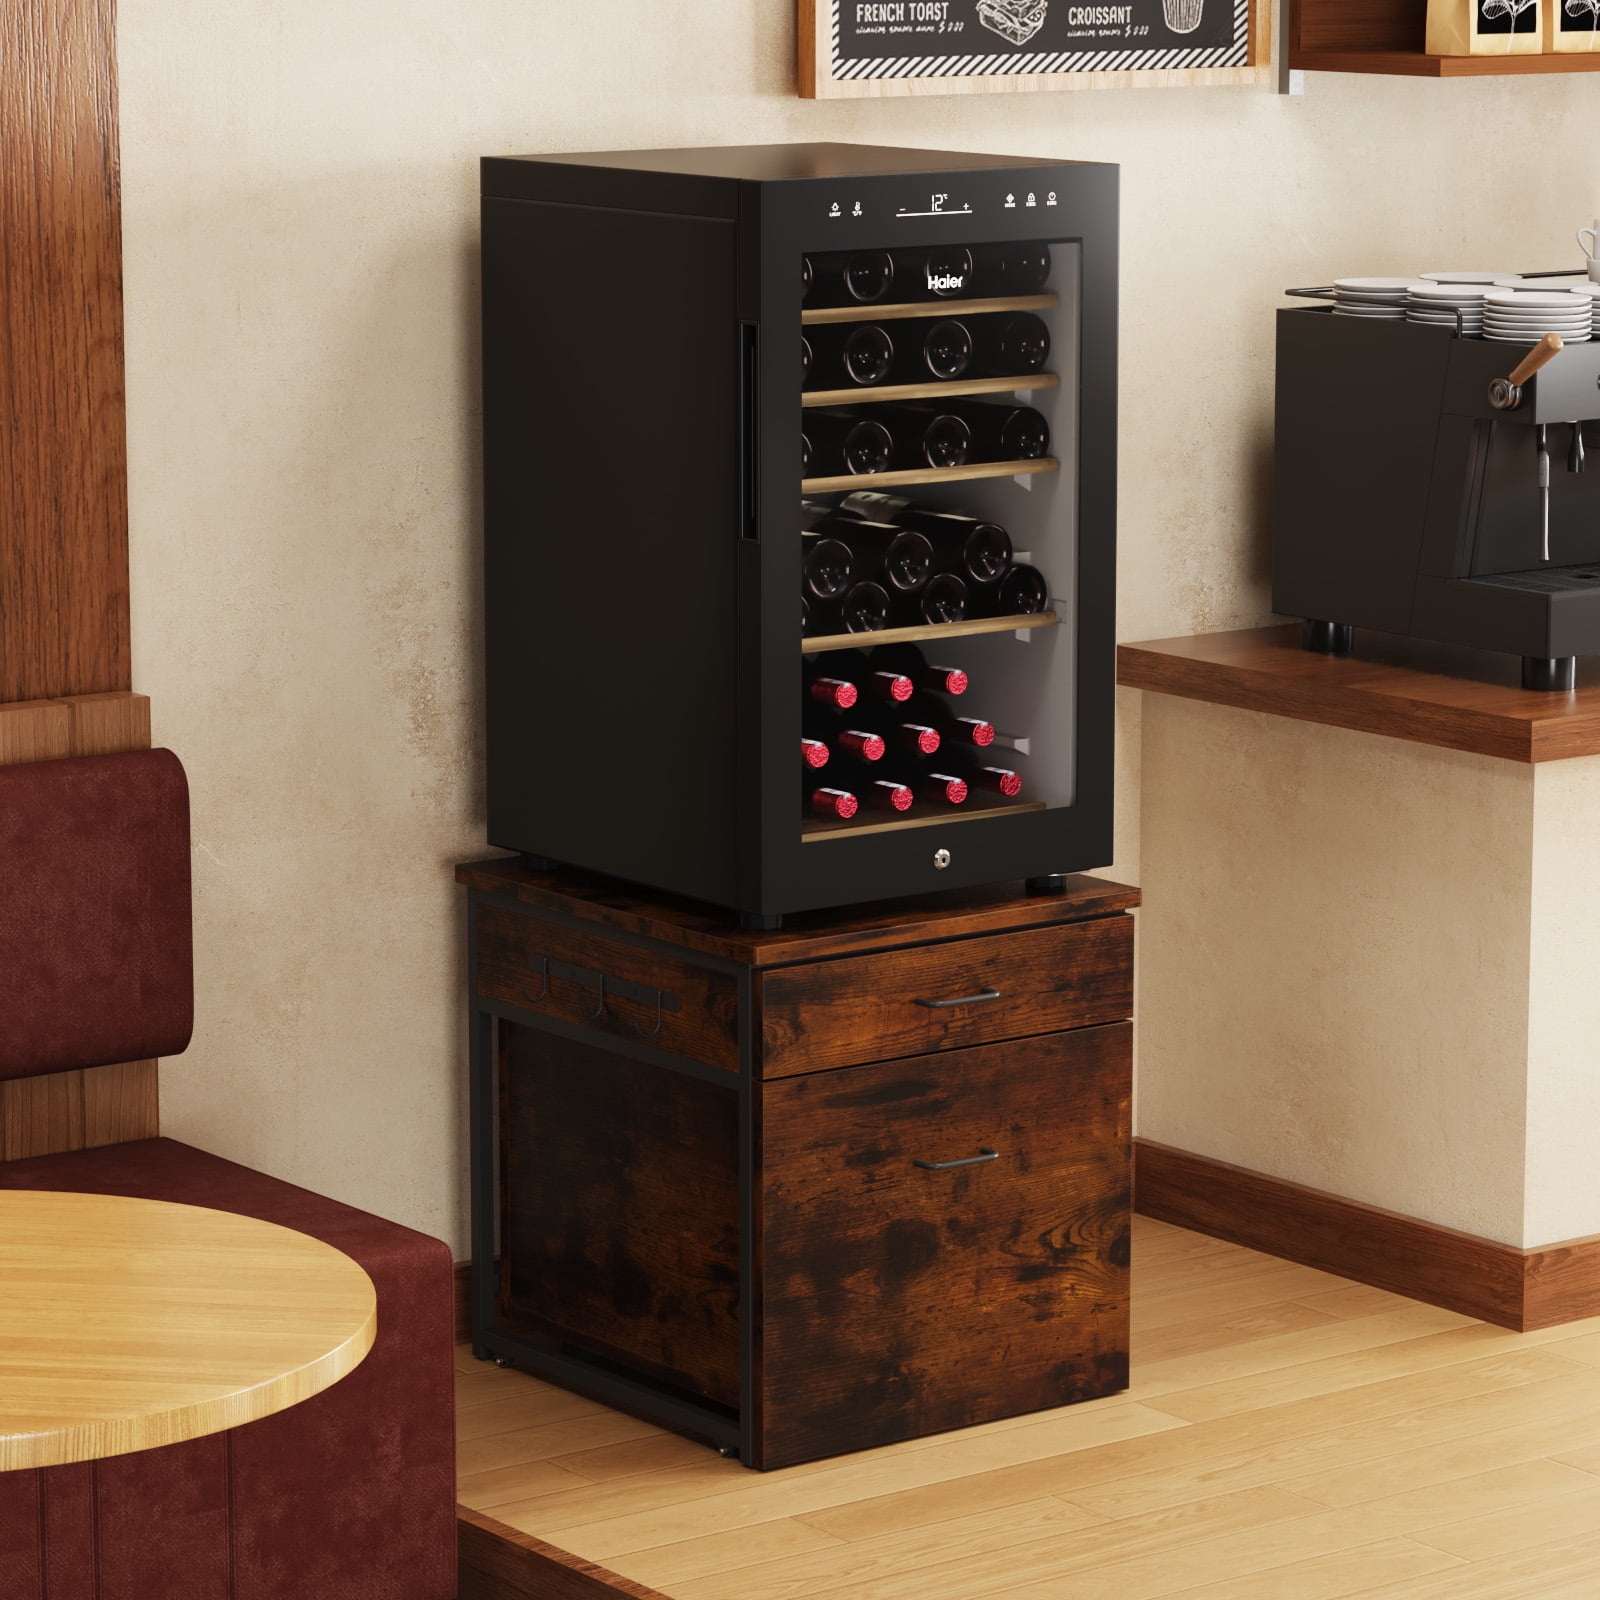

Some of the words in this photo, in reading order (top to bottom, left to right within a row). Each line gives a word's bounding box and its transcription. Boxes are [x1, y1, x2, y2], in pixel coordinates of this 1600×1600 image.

[856, 3, 904, 22] FRENCH
[908, 2, 949, 22] TOAST
[1068, 6, 1133, 25] CROISSANT
[928, 273, 963, 290] Haier
